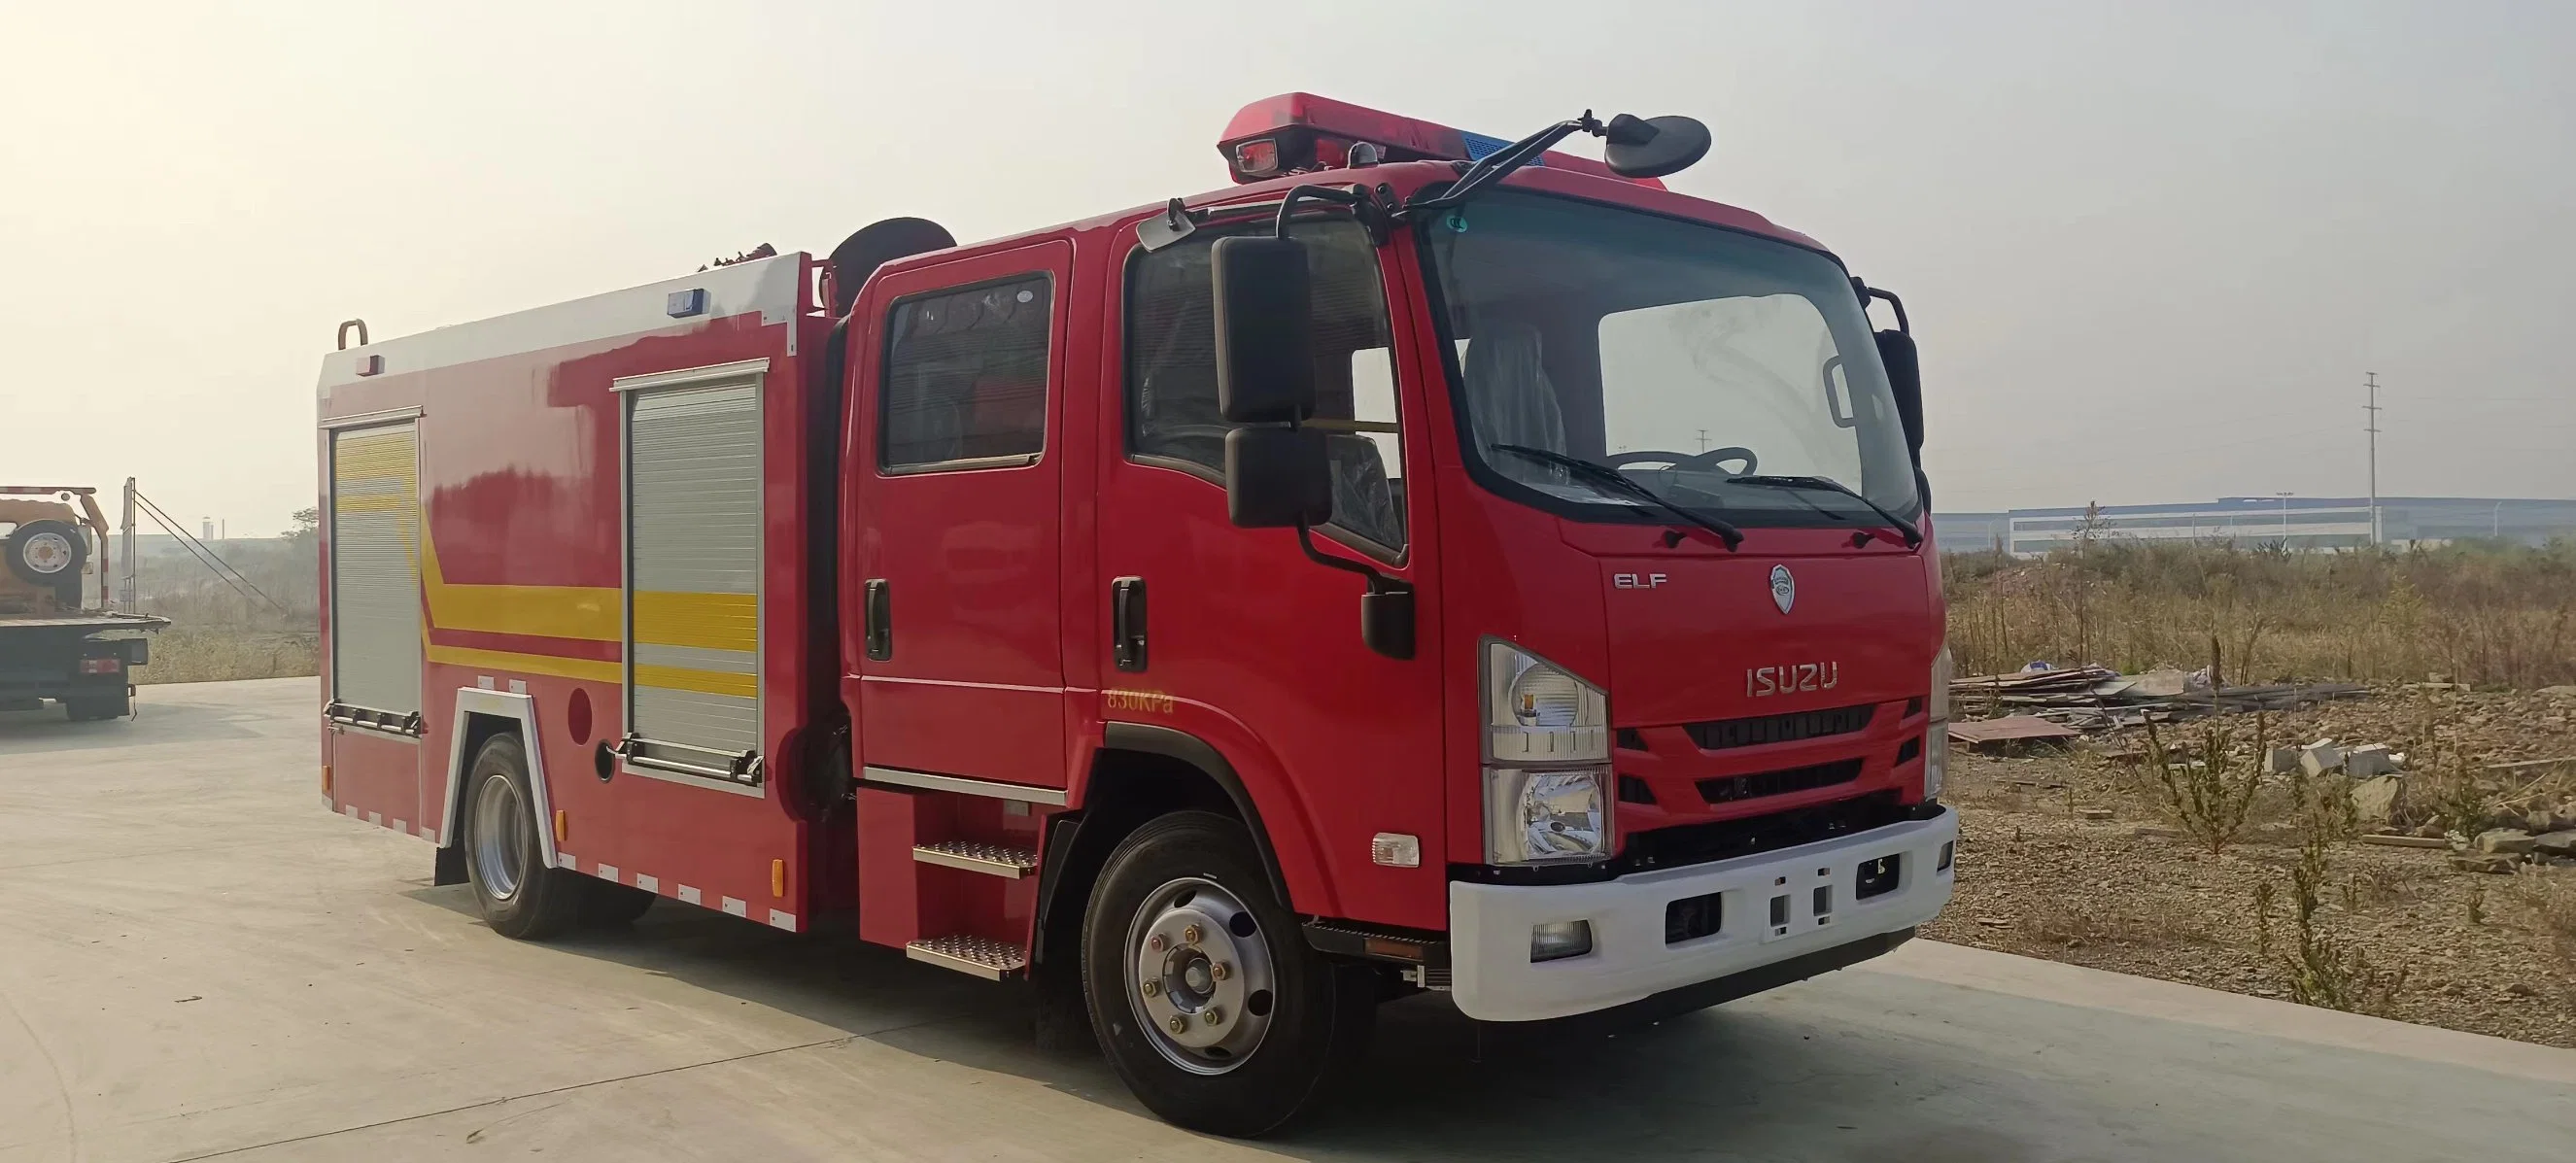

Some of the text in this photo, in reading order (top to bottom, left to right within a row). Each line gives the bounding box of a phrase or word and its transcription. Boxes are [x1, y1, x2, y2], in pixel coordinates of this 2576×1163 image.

[1614, 573, 1667, 589] ELF
[1746, 661, 1838, 698] ISUZU
[1108, 688, 1174, 714] 830KPa
